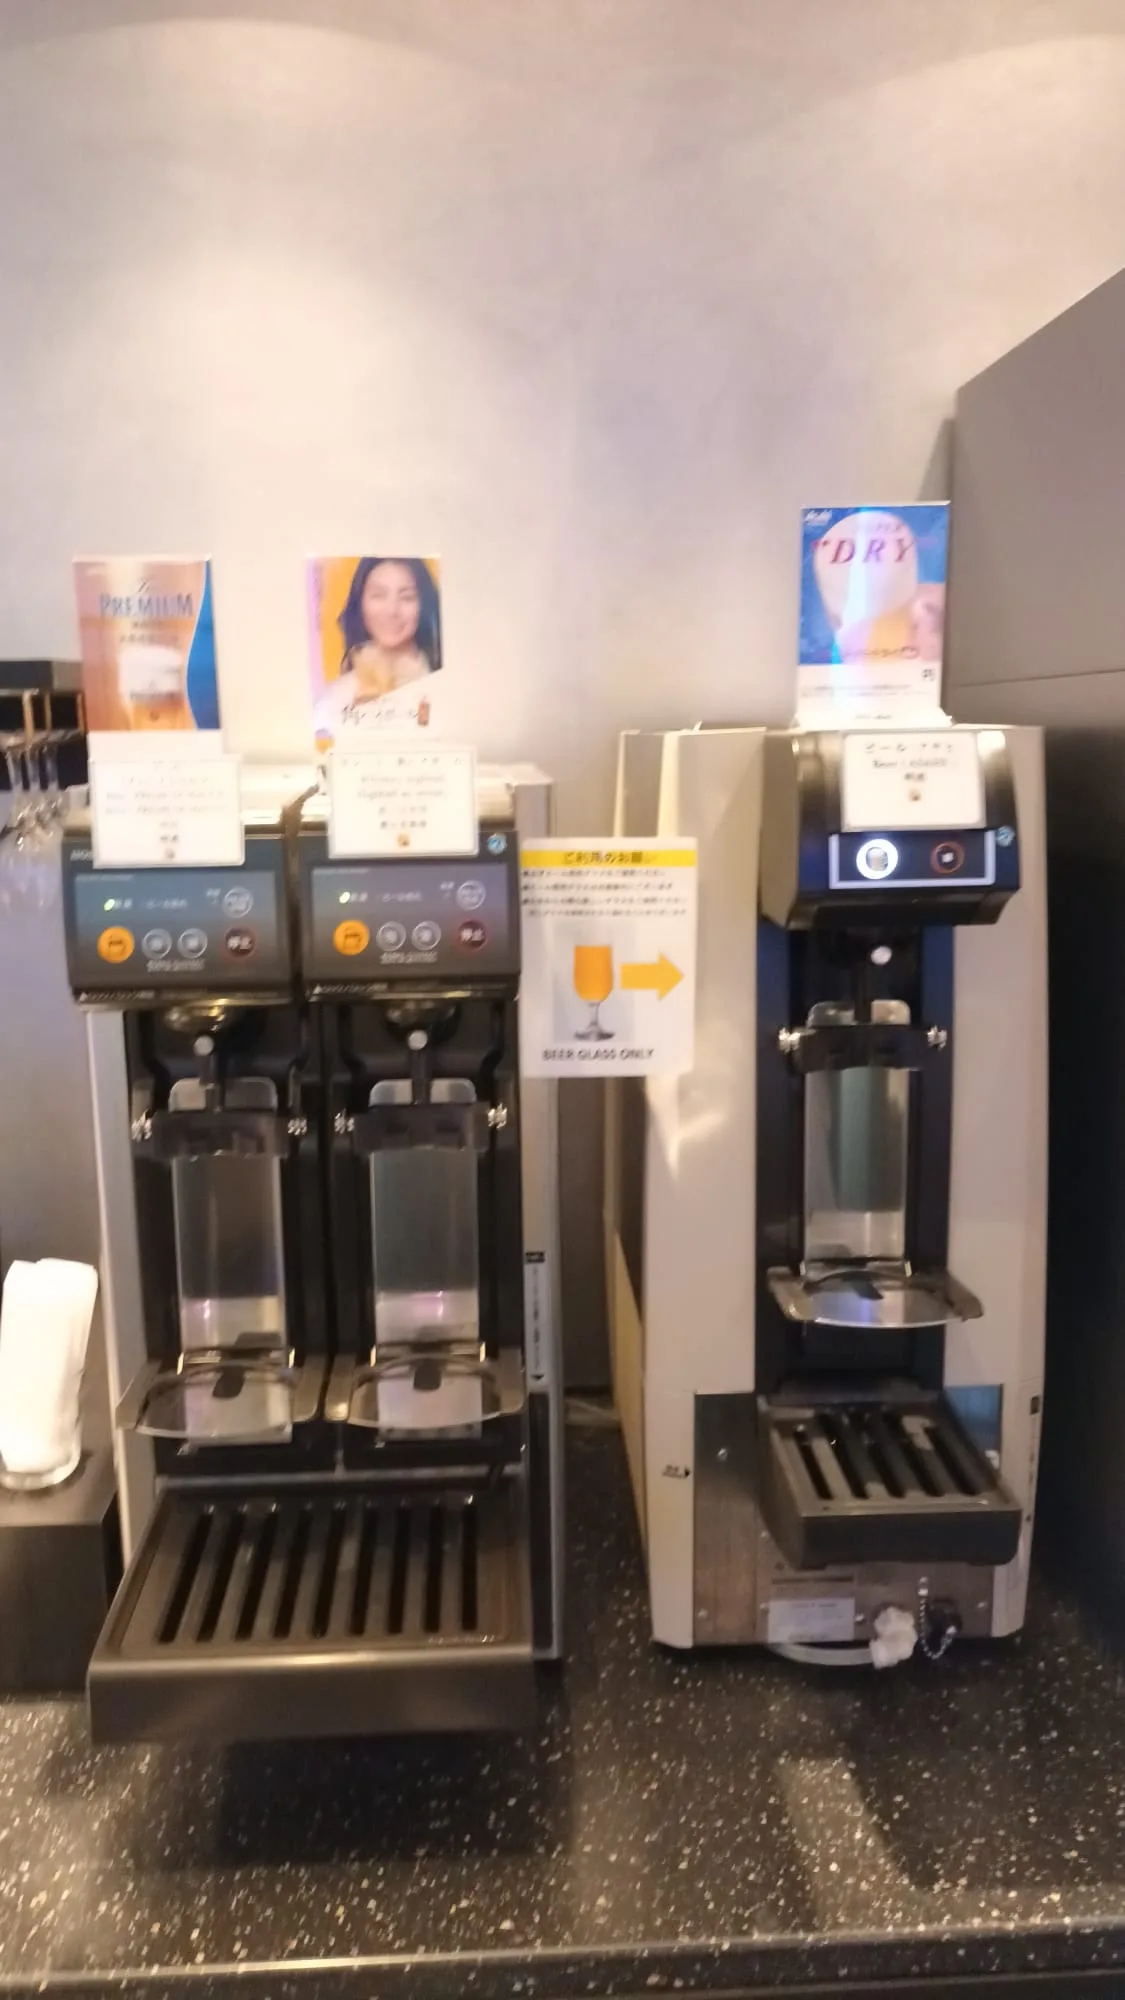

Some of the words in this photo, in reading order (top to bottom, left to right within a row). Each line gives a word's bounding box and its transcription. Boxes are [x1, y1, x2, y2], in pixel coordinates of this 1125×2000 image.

[830, 538, 914, 564] DRY
[99, 592, 193, 617] PREMIUM
[542, 1048, 574, 1061] BEER
[577, 1048, 616, 1060] GLASS
[619, 1048, 655, 1060] ONLY
